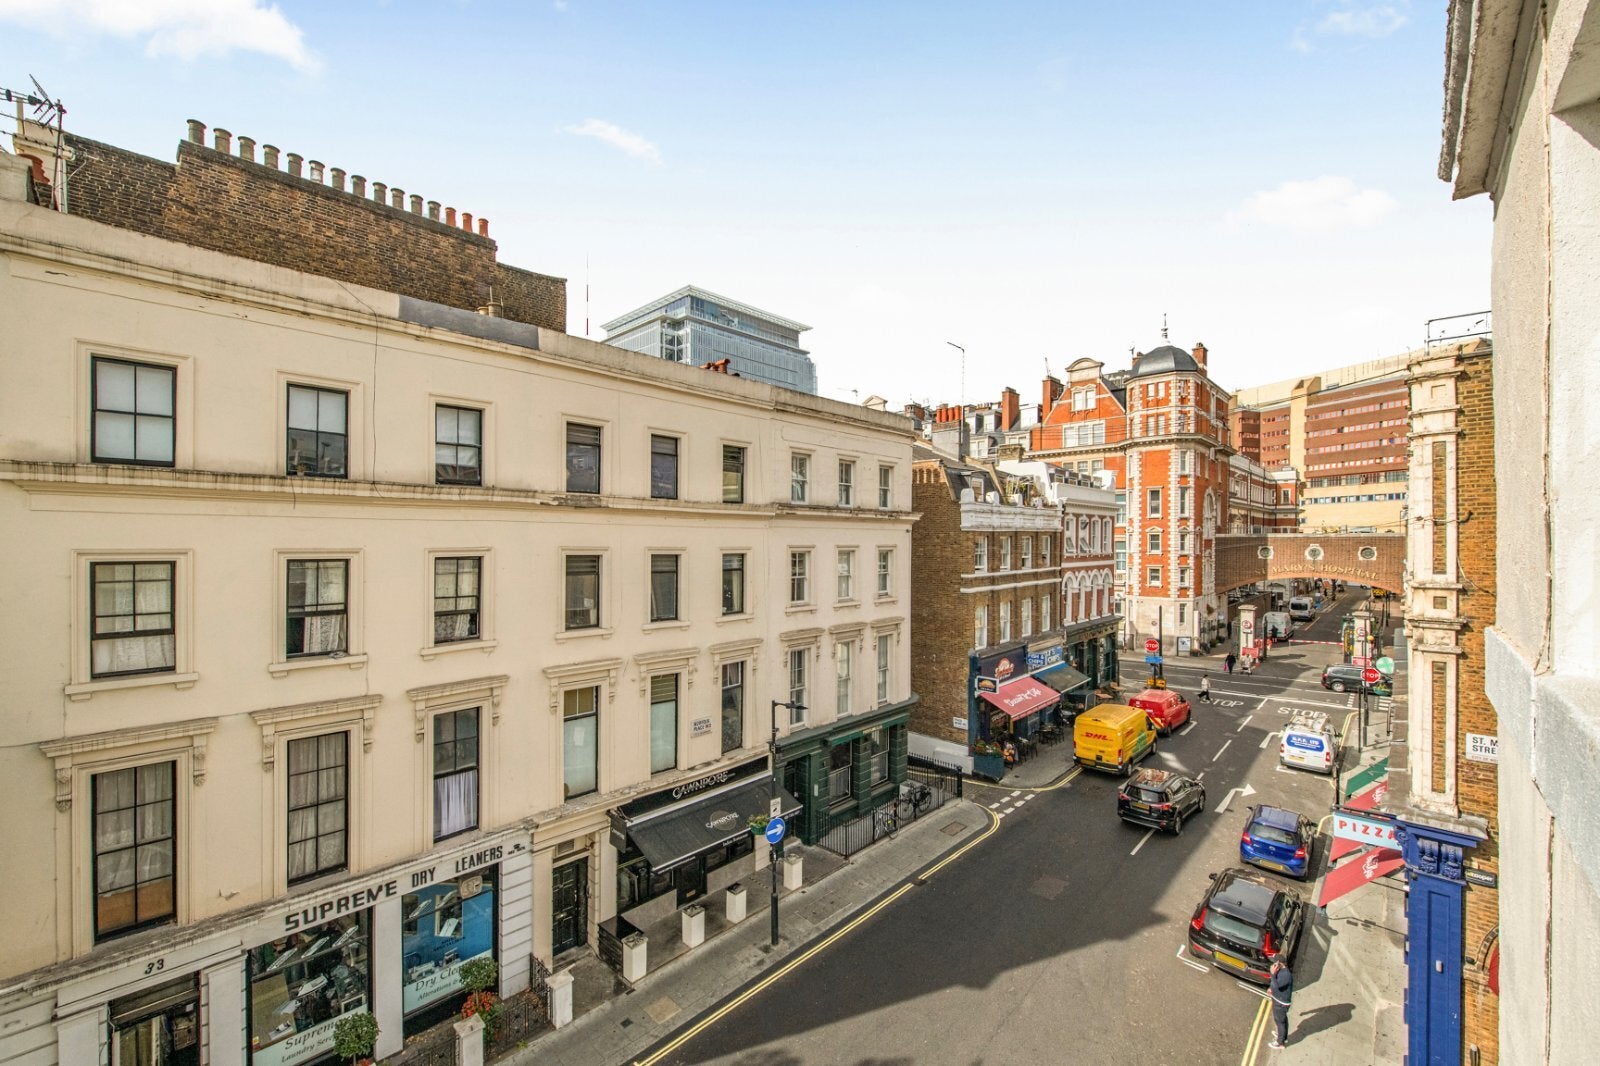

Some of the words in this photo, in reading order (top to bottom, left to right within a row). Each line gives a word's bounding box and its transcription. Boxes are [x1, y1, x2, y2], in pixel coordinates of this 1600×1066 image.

[1320, 563, 1378, 580] HOSPITAL
[1028, 658, 1045, 666] CHIPS
[1200, 698, 1244, 708] STOP
[1277, 706, 1329, 720] STOP
[1084, 731, 1110, 741] DHL
[1472, 736, 1486, 746] ST.
[1472, 744, 1497, 755] STRE
[1338, 819, 1396, 841] PIZZA
[285, 880, 398, 931] SUPREME
[412, 866, 436, 888] DRY
[455, 845, 504, 873] LEANERS
[144, 958, 165, 975] 33
[415, 976, 437, 992] Dry
[281, 1043, 316, 1063] Laundry
